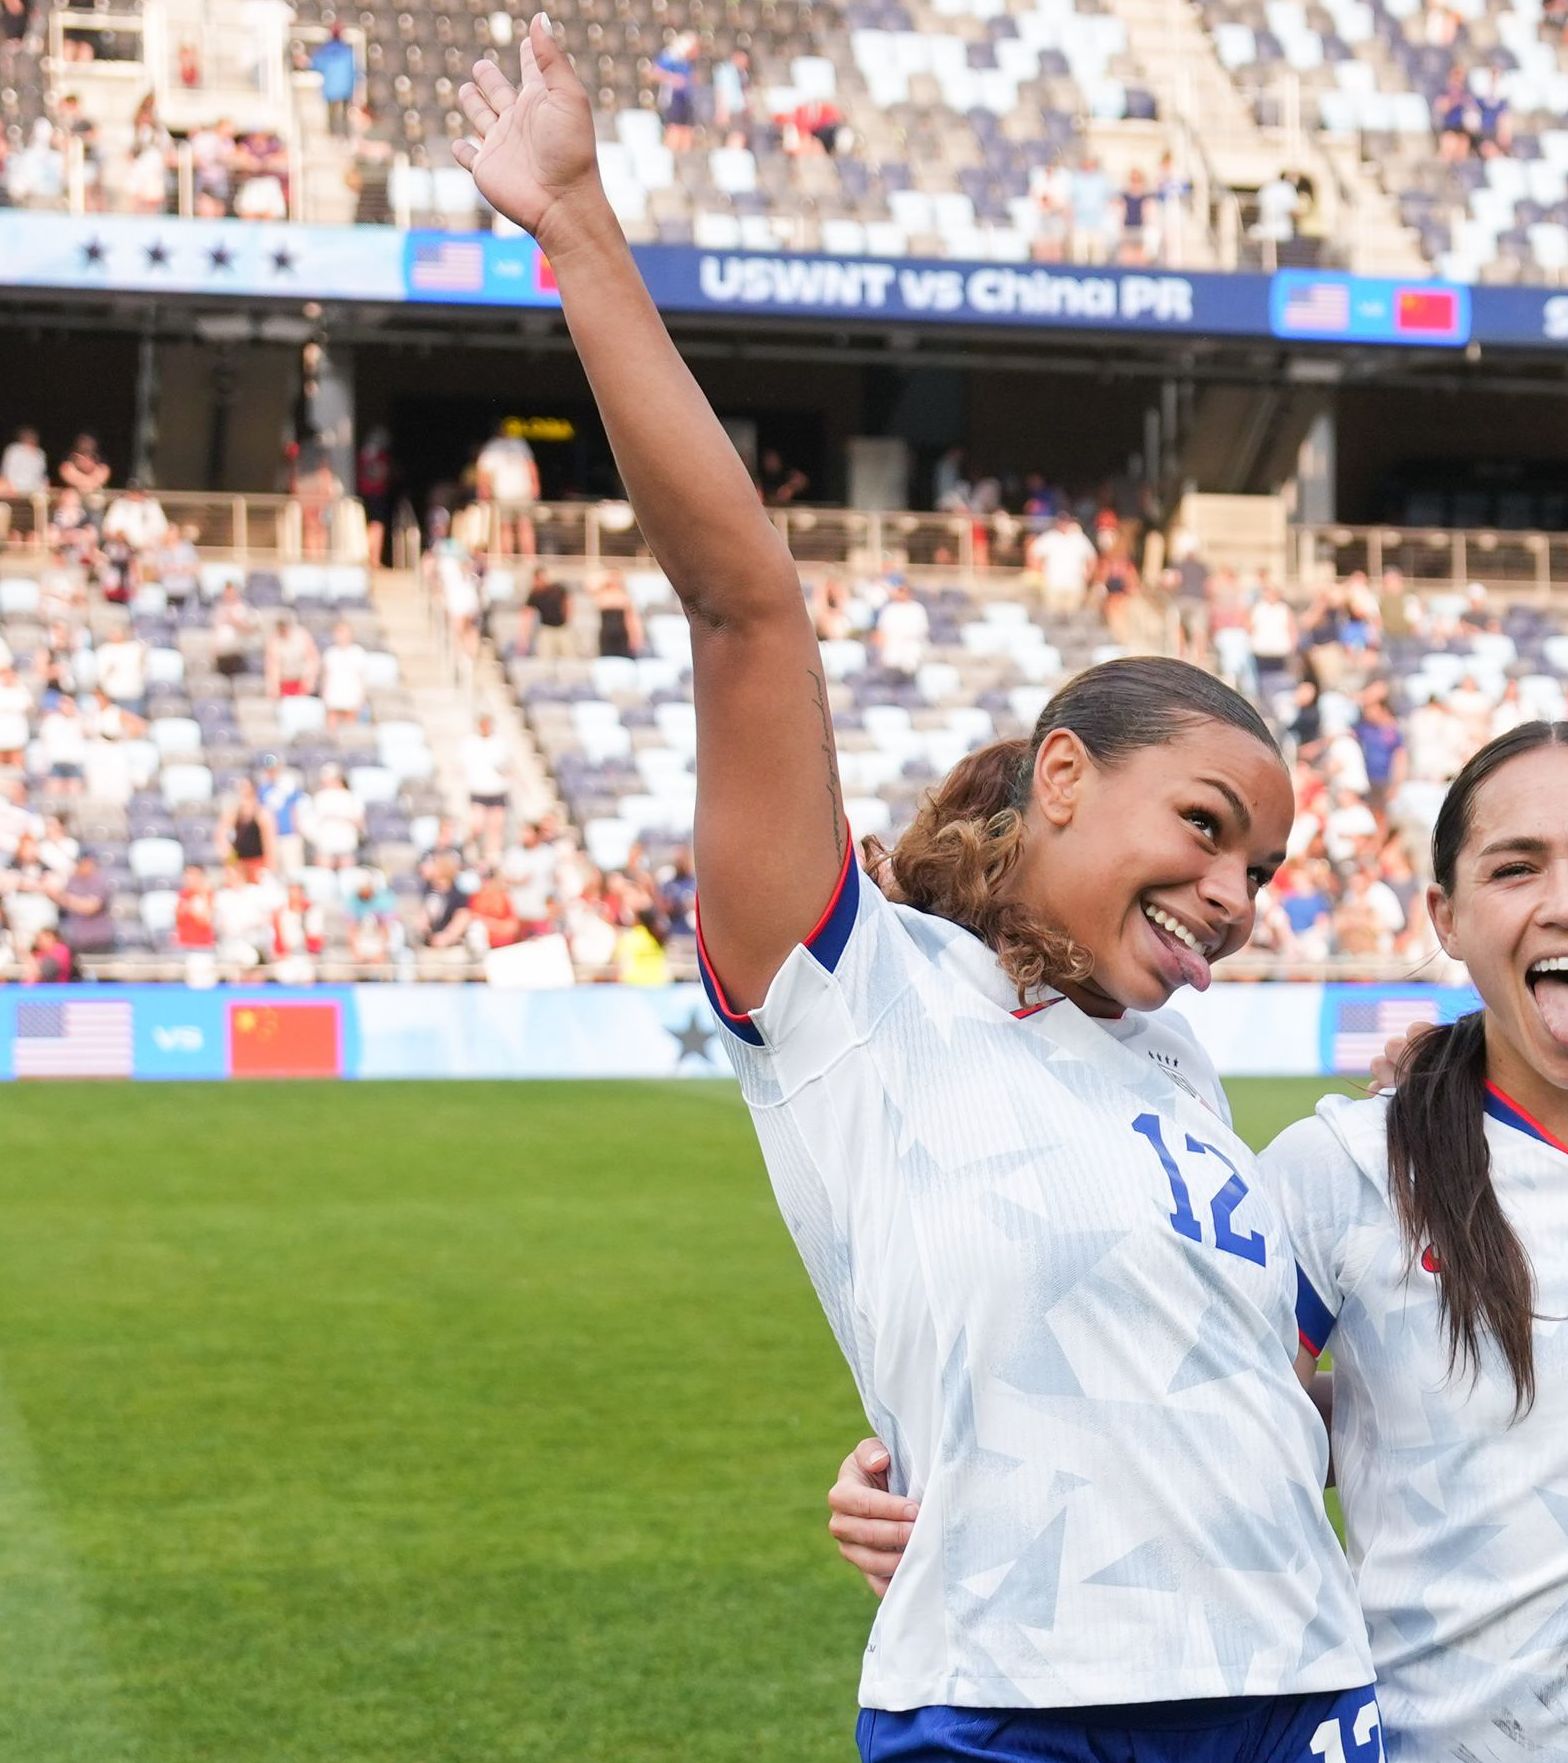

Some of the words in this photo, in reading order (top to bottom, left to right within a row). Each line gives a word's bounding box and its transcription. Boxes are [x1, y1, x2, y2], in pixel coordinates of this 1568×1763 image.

[701, 255, 895, 308] USWNT
[901, 268, 964, 312] vs
[965, 267, 1118, 319] China
[1119, 275, 1194, 323] PR
[1131, 1113, 1266, 1268] 12
